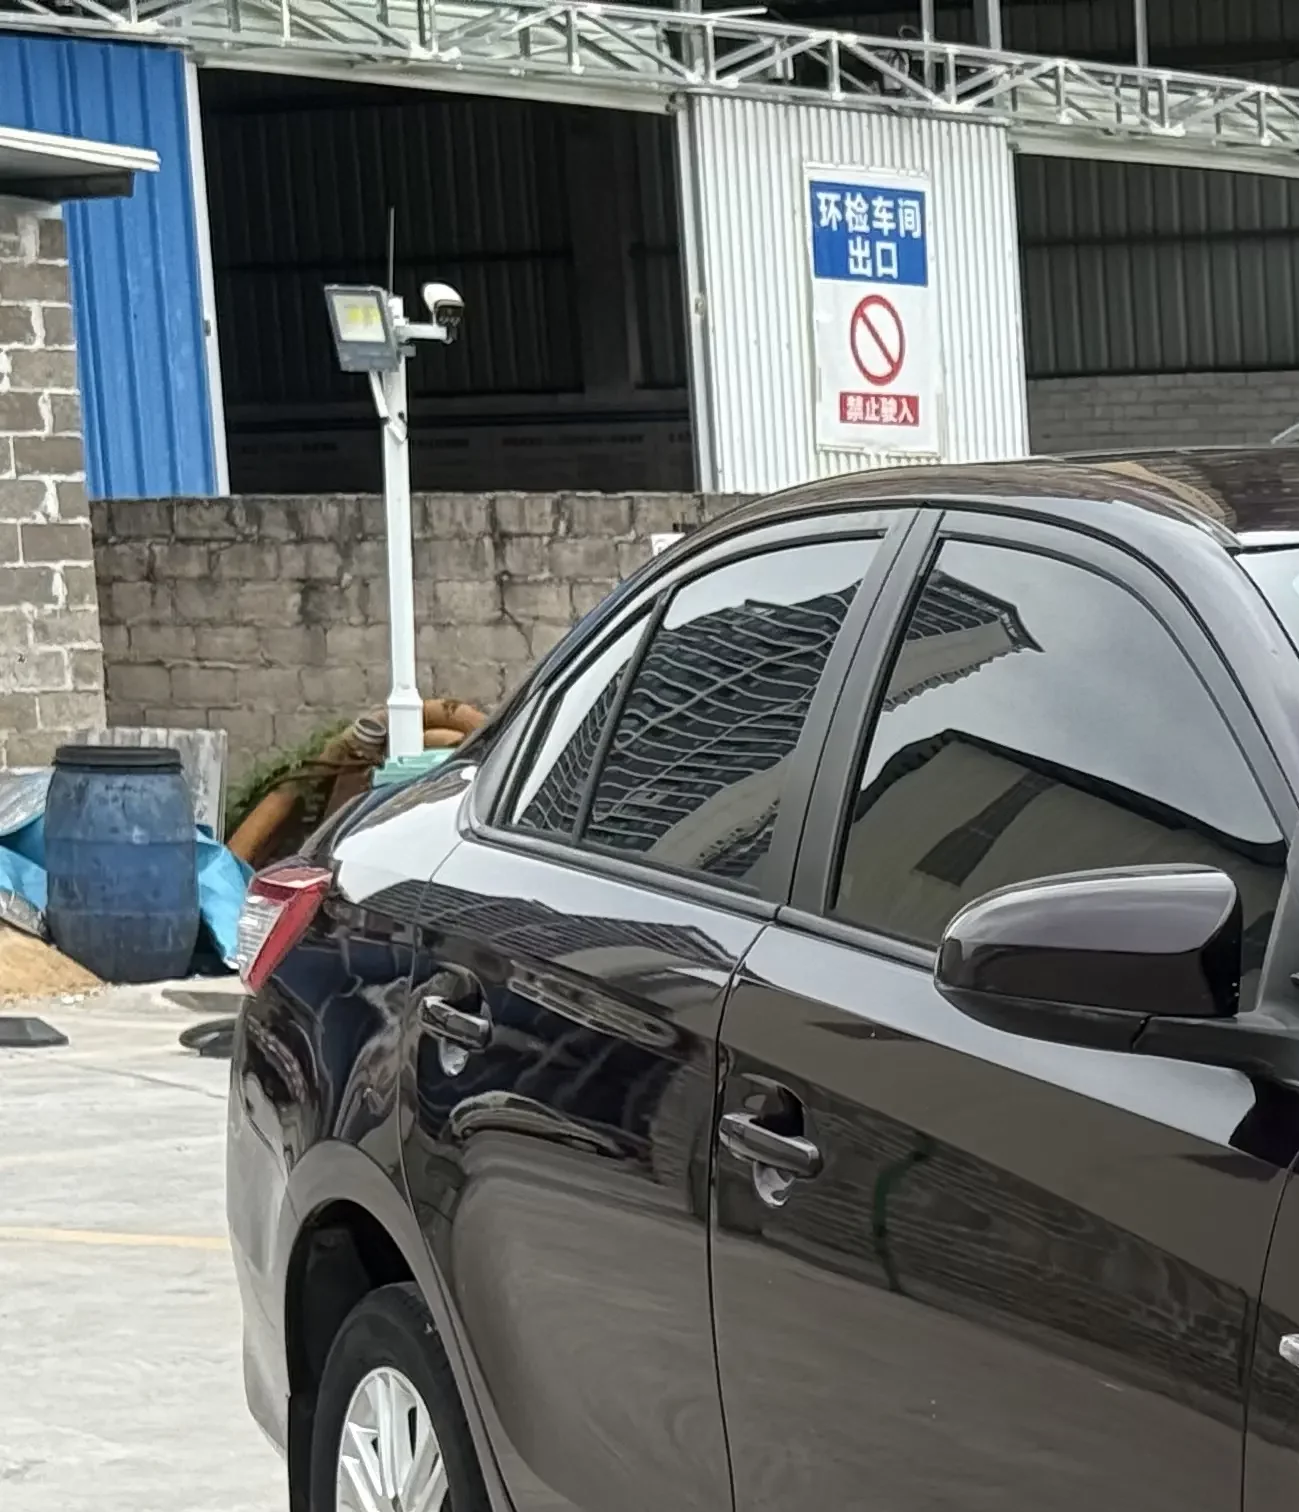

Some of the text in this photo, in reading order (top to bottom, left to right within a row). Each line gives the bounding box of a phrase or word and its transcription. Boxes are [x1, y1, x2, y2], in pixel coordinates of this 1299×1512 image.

[816, 192, 922, 239] 环检车间
[848, 236, 899, 279] 出口
[846, 395, 915, 424] 禁止驶入
